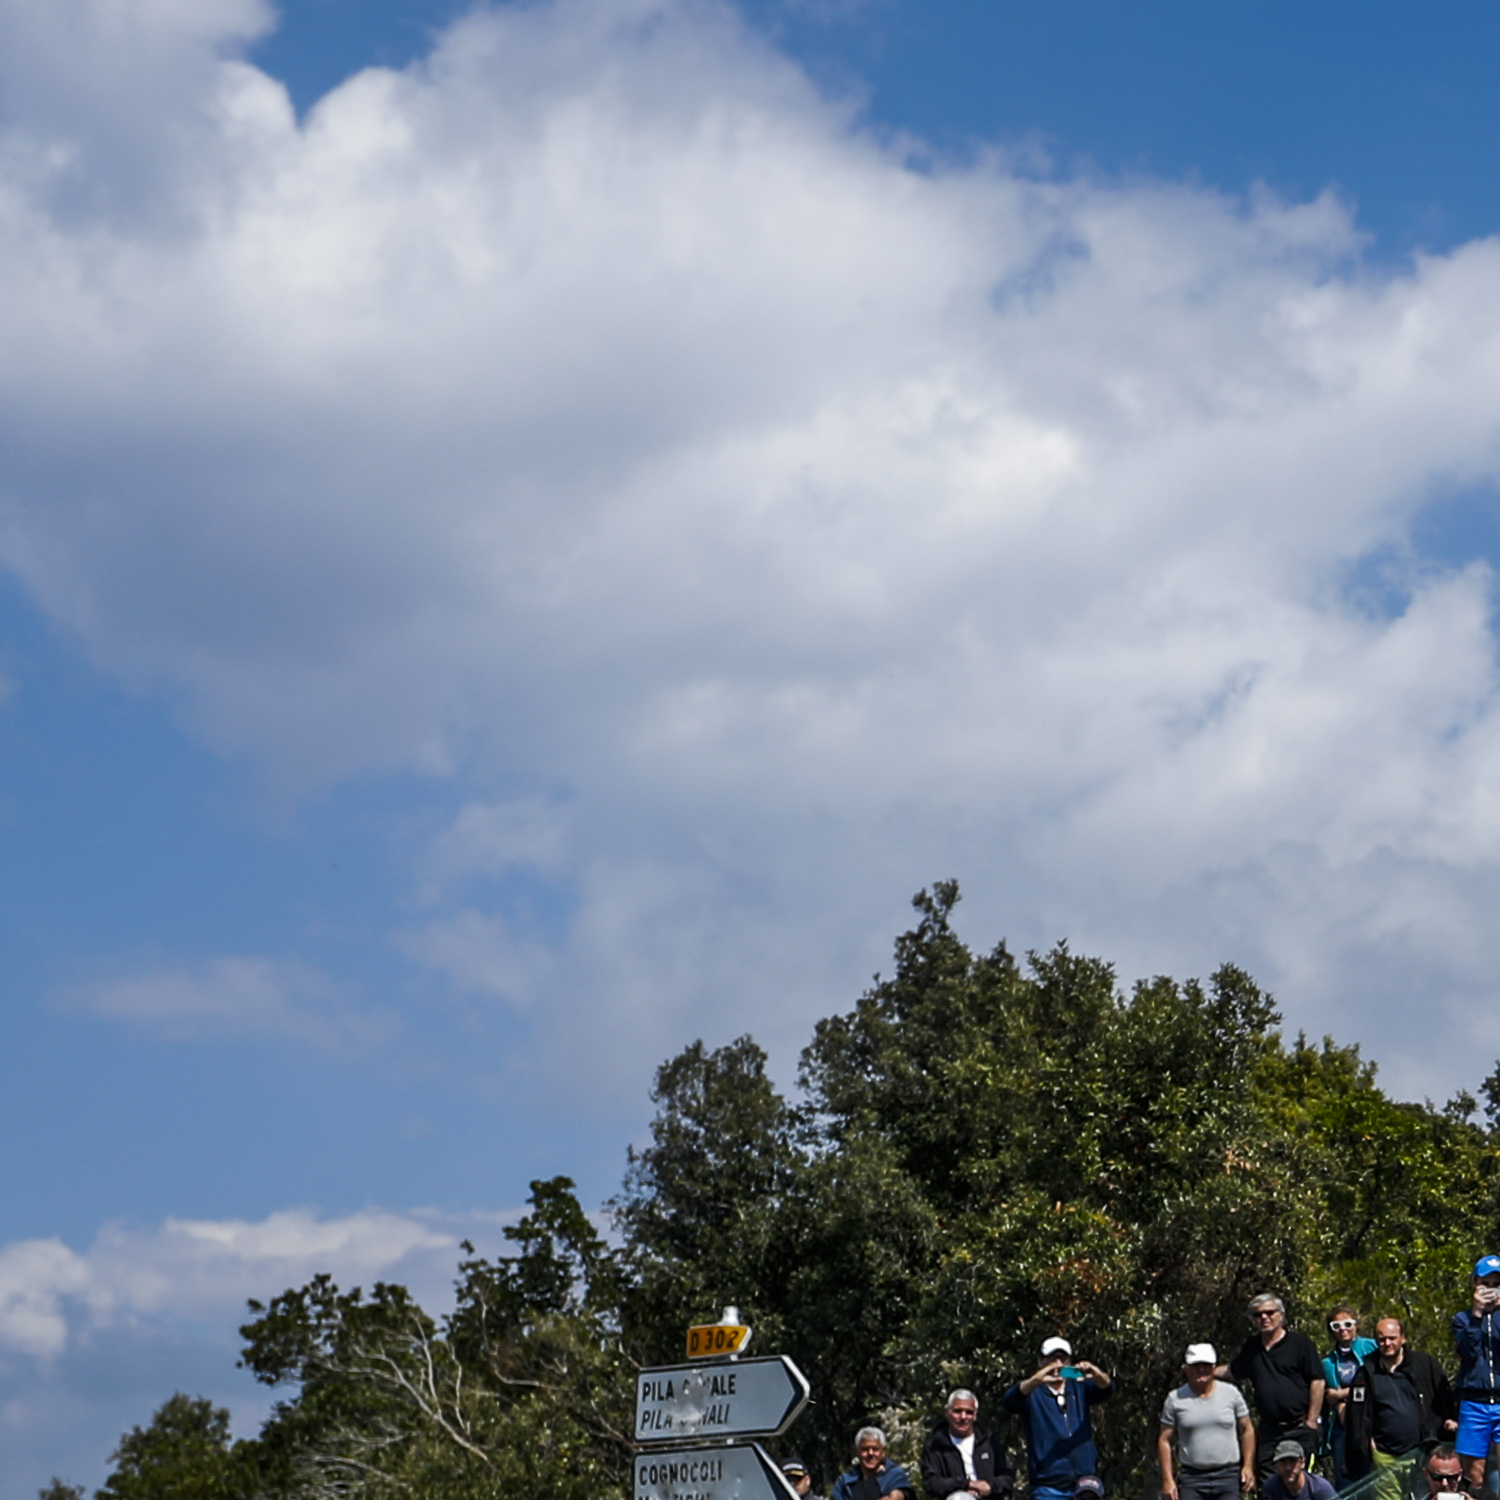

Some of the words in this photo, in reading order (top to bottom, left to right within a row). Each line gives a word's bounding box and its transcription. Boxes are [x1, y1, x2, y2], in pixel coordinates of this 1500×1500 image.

[690, 1331, 700, 1353] D
[704, 1330, 739, 1350] 302
[642, 1379, 675, 1402] PILA
[639, 1459, 723, 1486] COGNOCOLI
